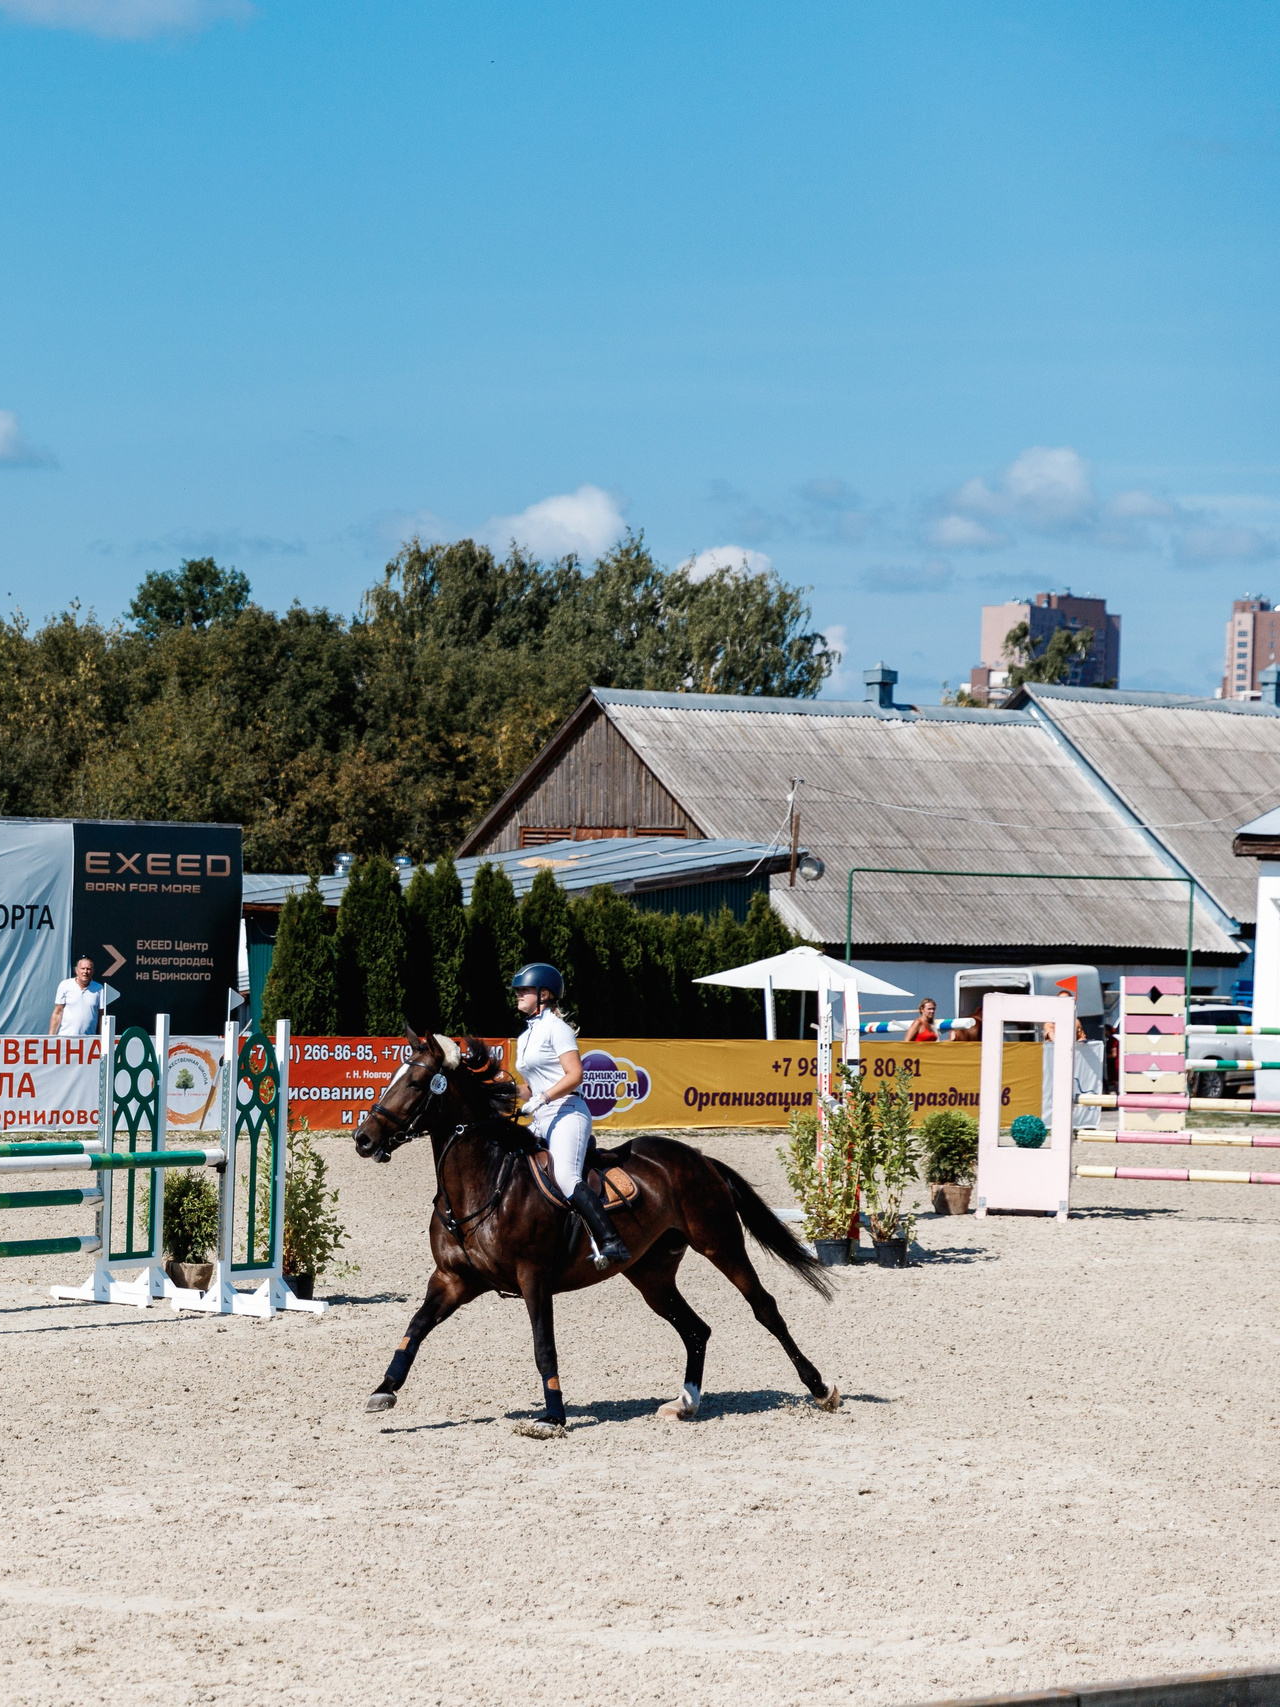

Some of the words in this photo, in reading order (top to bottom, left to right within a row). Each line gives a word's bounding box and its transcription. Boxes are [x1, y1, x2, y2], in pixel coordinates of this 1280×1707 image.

[85, 851, 231, 877] EXEED
[85, 882, 126, 892] BORN
[129, 883, 158, 893] FOR
[161, 884, 201, 894] MORE
[136, 940, 172, 950] EXEED
[174, 940, 209, 952] Центр
[136, 955, 214, 967] Нижегородец
[135, 971, 149, 981] на
[152, 971, 211, 982] Бринского
[304, 1044, 377, 1063] 266-86-85,
[772, 1058, 792, 1077] +7
[874, 1058, 896, 1077] 80
[353, 1071, 361, 1079] Н.
[615, 1072, 627, 1080] на
[288, 1086, 374, 1100] исование
[684, 1086, 812, 1112] Организация
